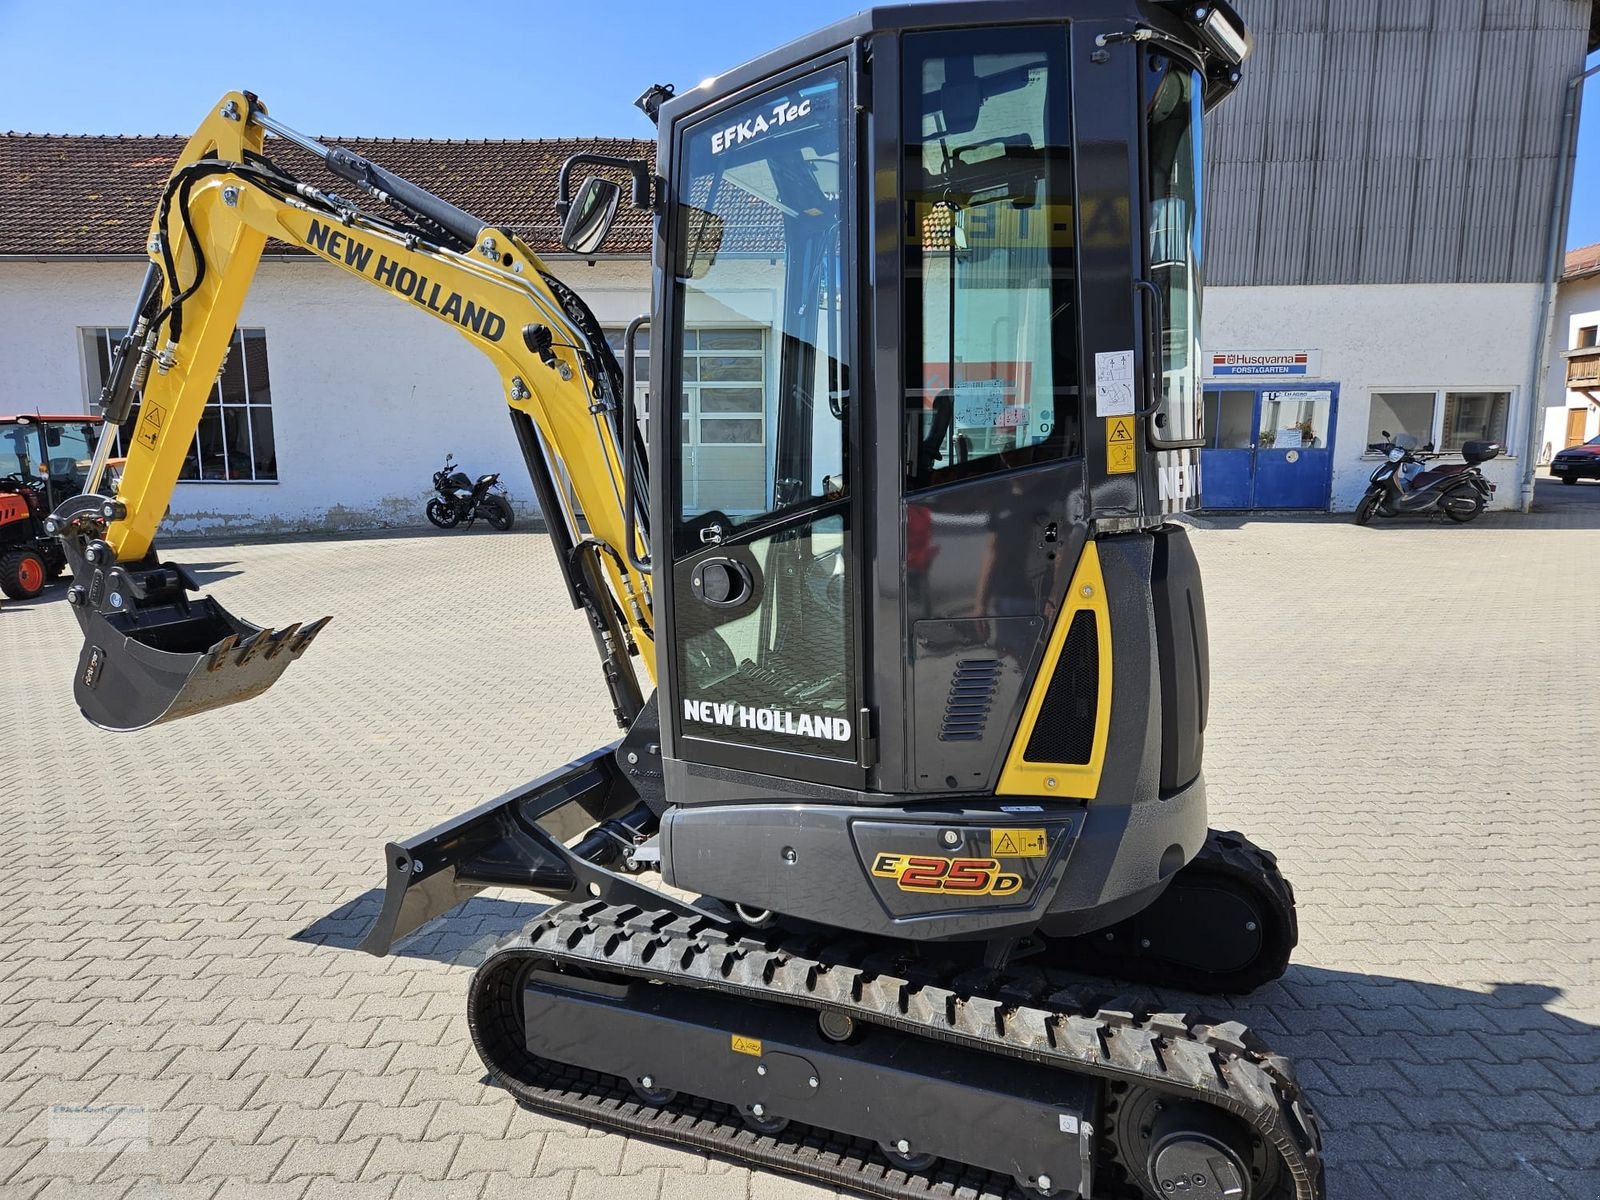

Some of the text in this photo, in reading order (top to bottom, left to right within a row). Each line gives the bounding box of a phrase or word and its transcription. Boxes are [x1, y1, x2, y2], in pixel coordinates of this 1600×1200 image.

[711, 99, 811, 154] EFKA-Tec
[306, 219, 506, 342] NEW HOLLAND
[1236, 354, 1294, 365] Husqvarna
[684, 699, 851, 742] NEW HOLLAND
